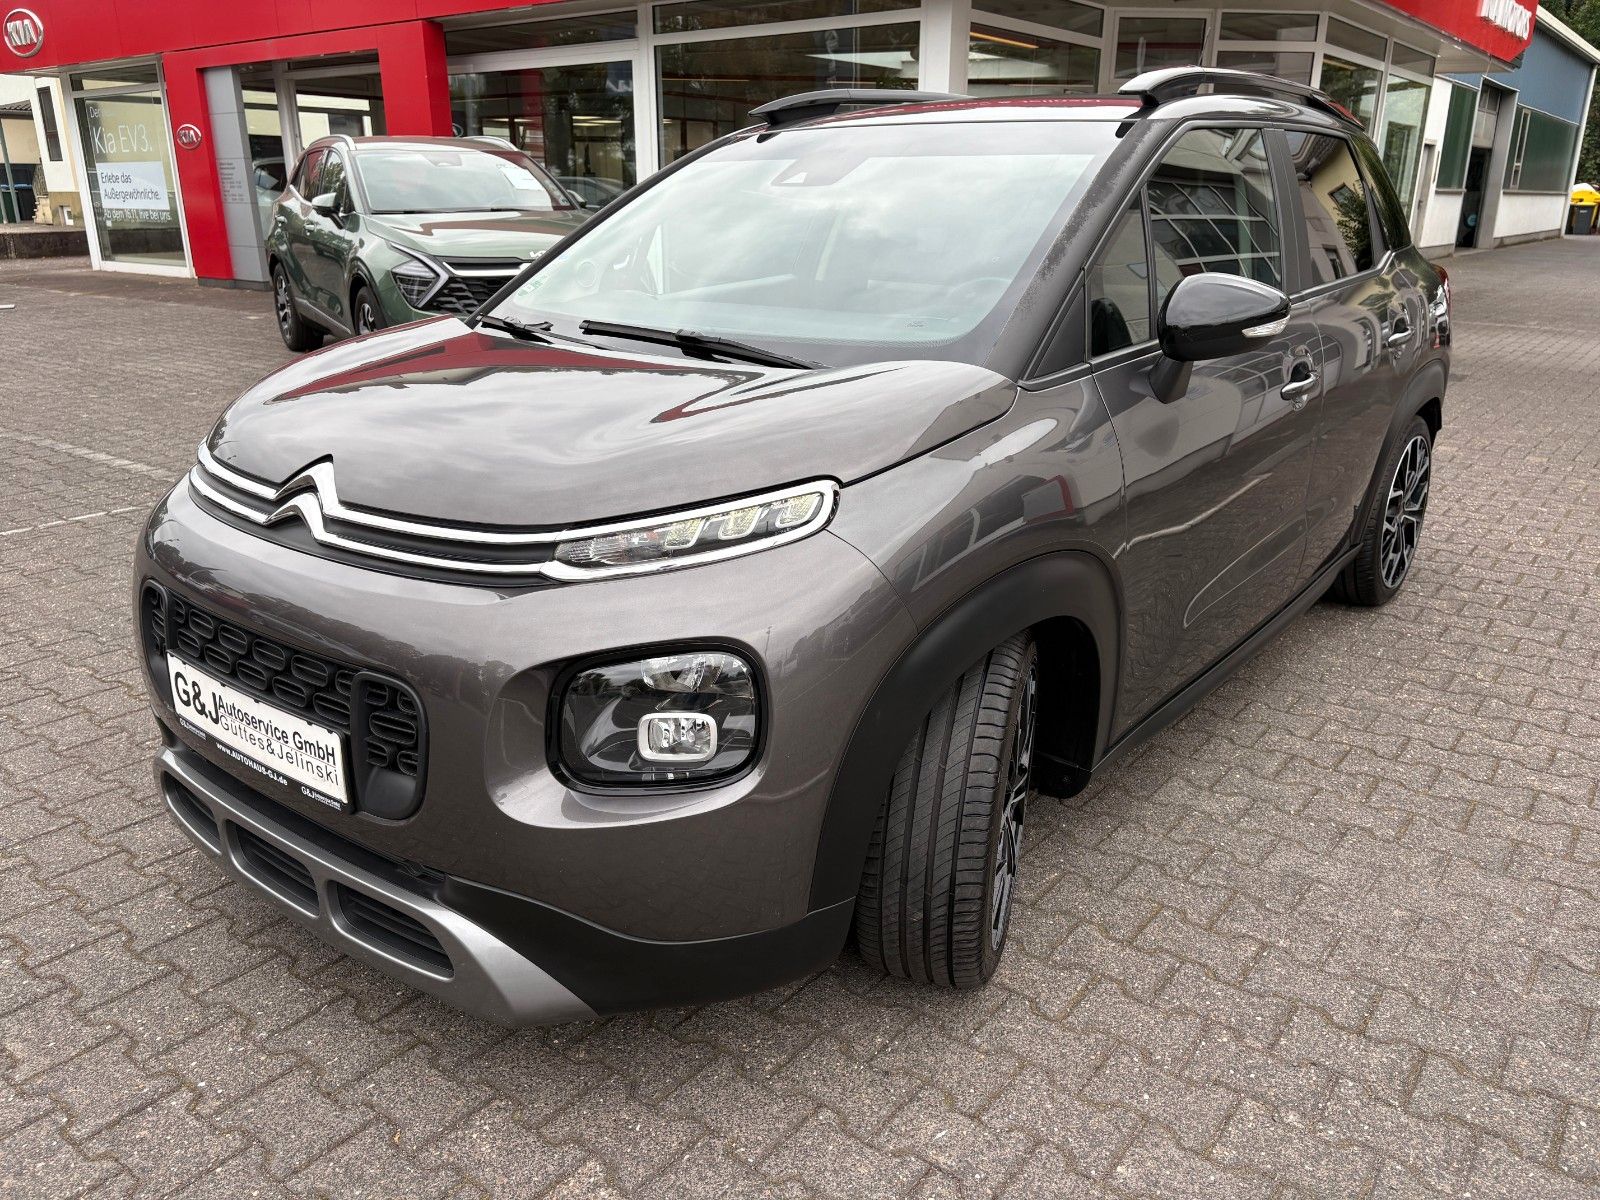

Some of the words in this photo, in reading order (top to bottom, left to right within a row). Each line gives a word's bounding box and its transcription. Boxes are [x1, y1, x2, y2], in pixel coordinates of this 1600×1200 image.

[7, 19, 37, 46] KIA
[93, 127, 116, 154] Kia
[101, 172, 119, 184] Erlebe
[120, 172, 132, 184] das
[175, 671, 219, 725] G&J
[218, 694, 289, 744] Autoservice
[292, 731, 336, 766] GmbH
[216, 741, 288, 786] www.AUTOHAUS-GJ.de
